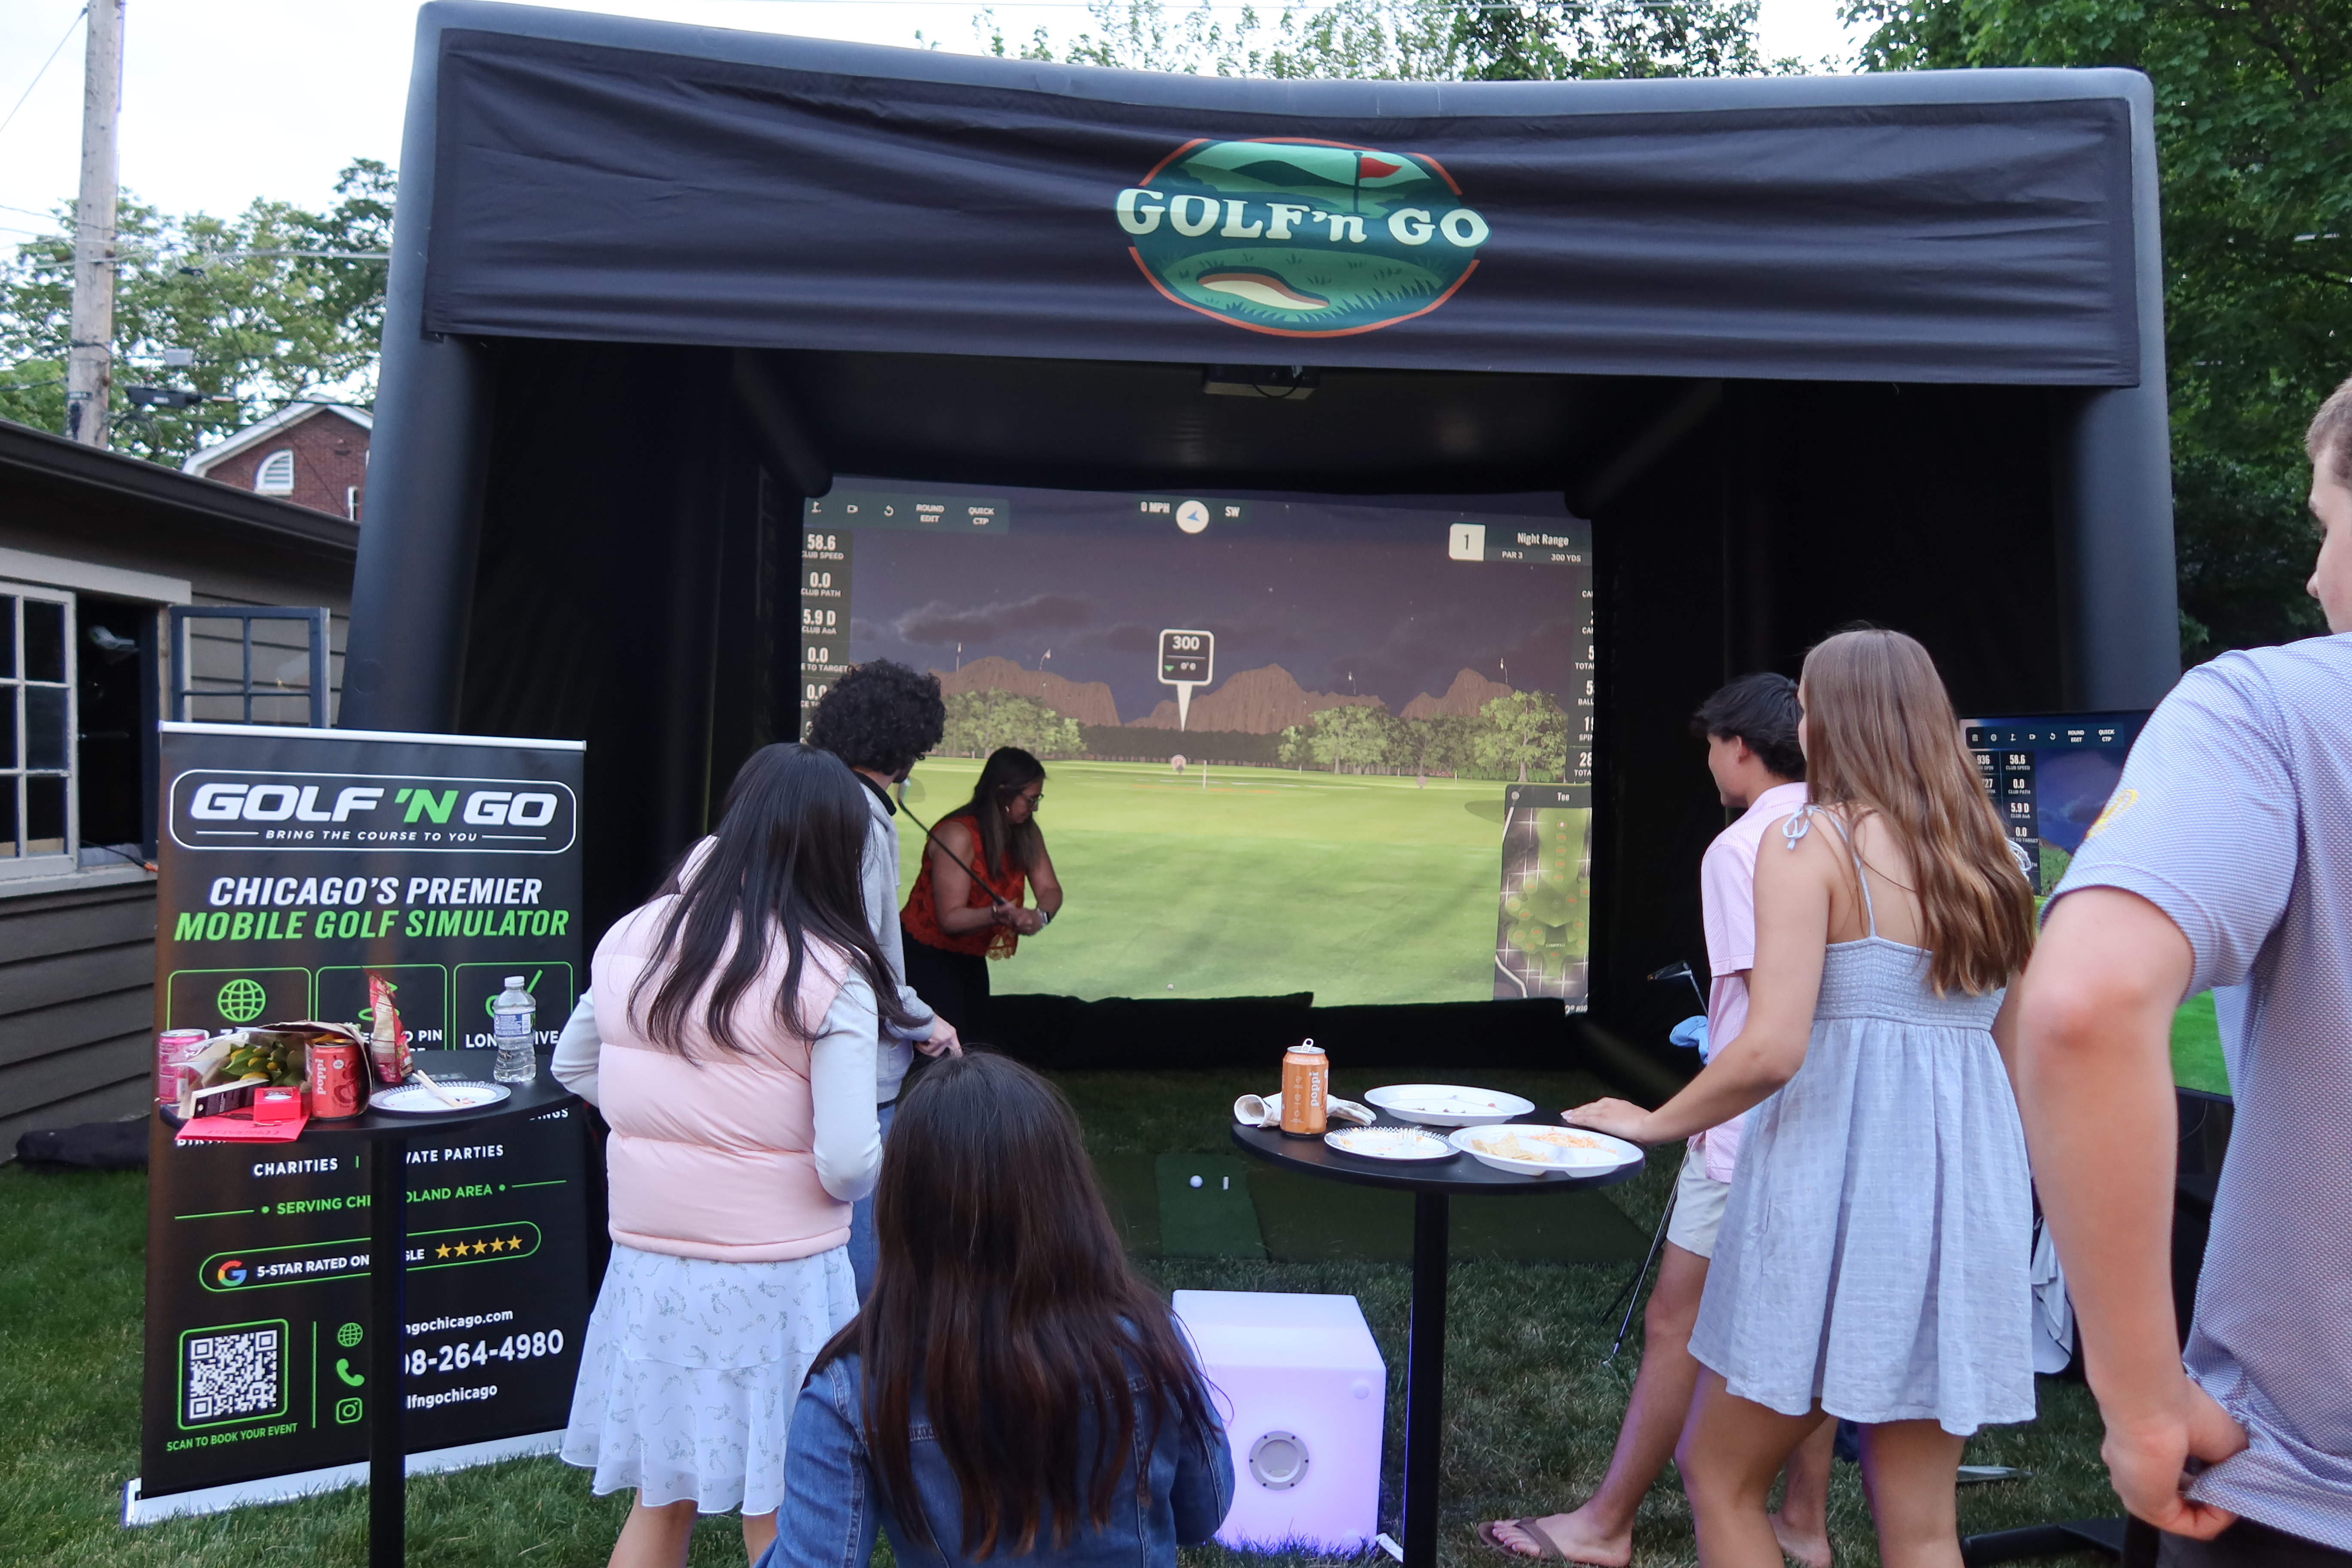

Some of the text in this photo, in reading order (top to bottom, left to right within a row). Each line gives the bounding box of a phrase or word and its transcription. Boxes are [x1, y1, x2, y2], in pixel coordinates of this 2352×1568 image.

[1117, 188, 1490, 248] GOLF'n GO
[916, 504, 945, 513] ROUND
[968, 506, 995, 515] QUICK
[1140, 501, 1170, 513] 0 MPH
[1225, 506, 1240, 518] SW
[920, 514, 940, 523] EDIT
[972, 517, 989, 525] CTP
[807, 533, 836, 551] 58.6
[1464, 533, 1470, 551] 1
[1517, 532, 1569, 548] Night Range
[819, 551, 844, 560] SPEED
[1501, 551, 1517, 559] PAR
[1551, 553, 1581, 563] 300 YDS
[810, 571, 831, 588] 0.0
[801, 588, 841, 597] CLUB PATH
[803, 608, 836, 626] 5.9 D
[801, 625, 821, 634] CLUB
[1172, 635, 1200, 650] 300
[808, 646, 829, 663] 0.0
[807, 662, 817, 671] TO
[819, 664, 848, 672] TARGET
[1578, 698, 1594, 706] BALL
[2009, 754, 2026, 765] 58.6
[2013, 778, 2024, 789] 0.0
[1557, 792, 1570, 802] Tee
[190, 783, 558, 827] GOLF 'N GO
[2011, 802, 2029, 813] 5.9 D
[266, 830, 478, 842] BRING THE COURSE TO YOU
[2015, 827, 2027, 837] 0.0
[209, 876, 543, 906] CHICAGO'S PREMIER
[174, 908, 570, 942] MOBILE GOLF SIMULATOR
[419, 1029, 442, 1041] PIN
[466, 1030, 559, 1048] LON IVE
[315, 1059, 327, 1095] poppi
[1309, 1071, 1321, 1107] poppi
[444, 1144, 504, 1161] PARTIES
[254, 1158, 338, 1176] CHARITIES
[277, 1197, 342, 1215] SERVING
[455, 1184, 493, 1198] AREA
[257, 1254, 370, 1277] 5-STAR RATED ON
[406, 1310, 513, 1335] ngochicago.com
[405, 1329, 564, 1375] 8-264-4980
[407, 1384, 498, 1409] lfngochicago
[166, 1423, 298, 1452] SCAN TO BOOK YOUR EVENT
